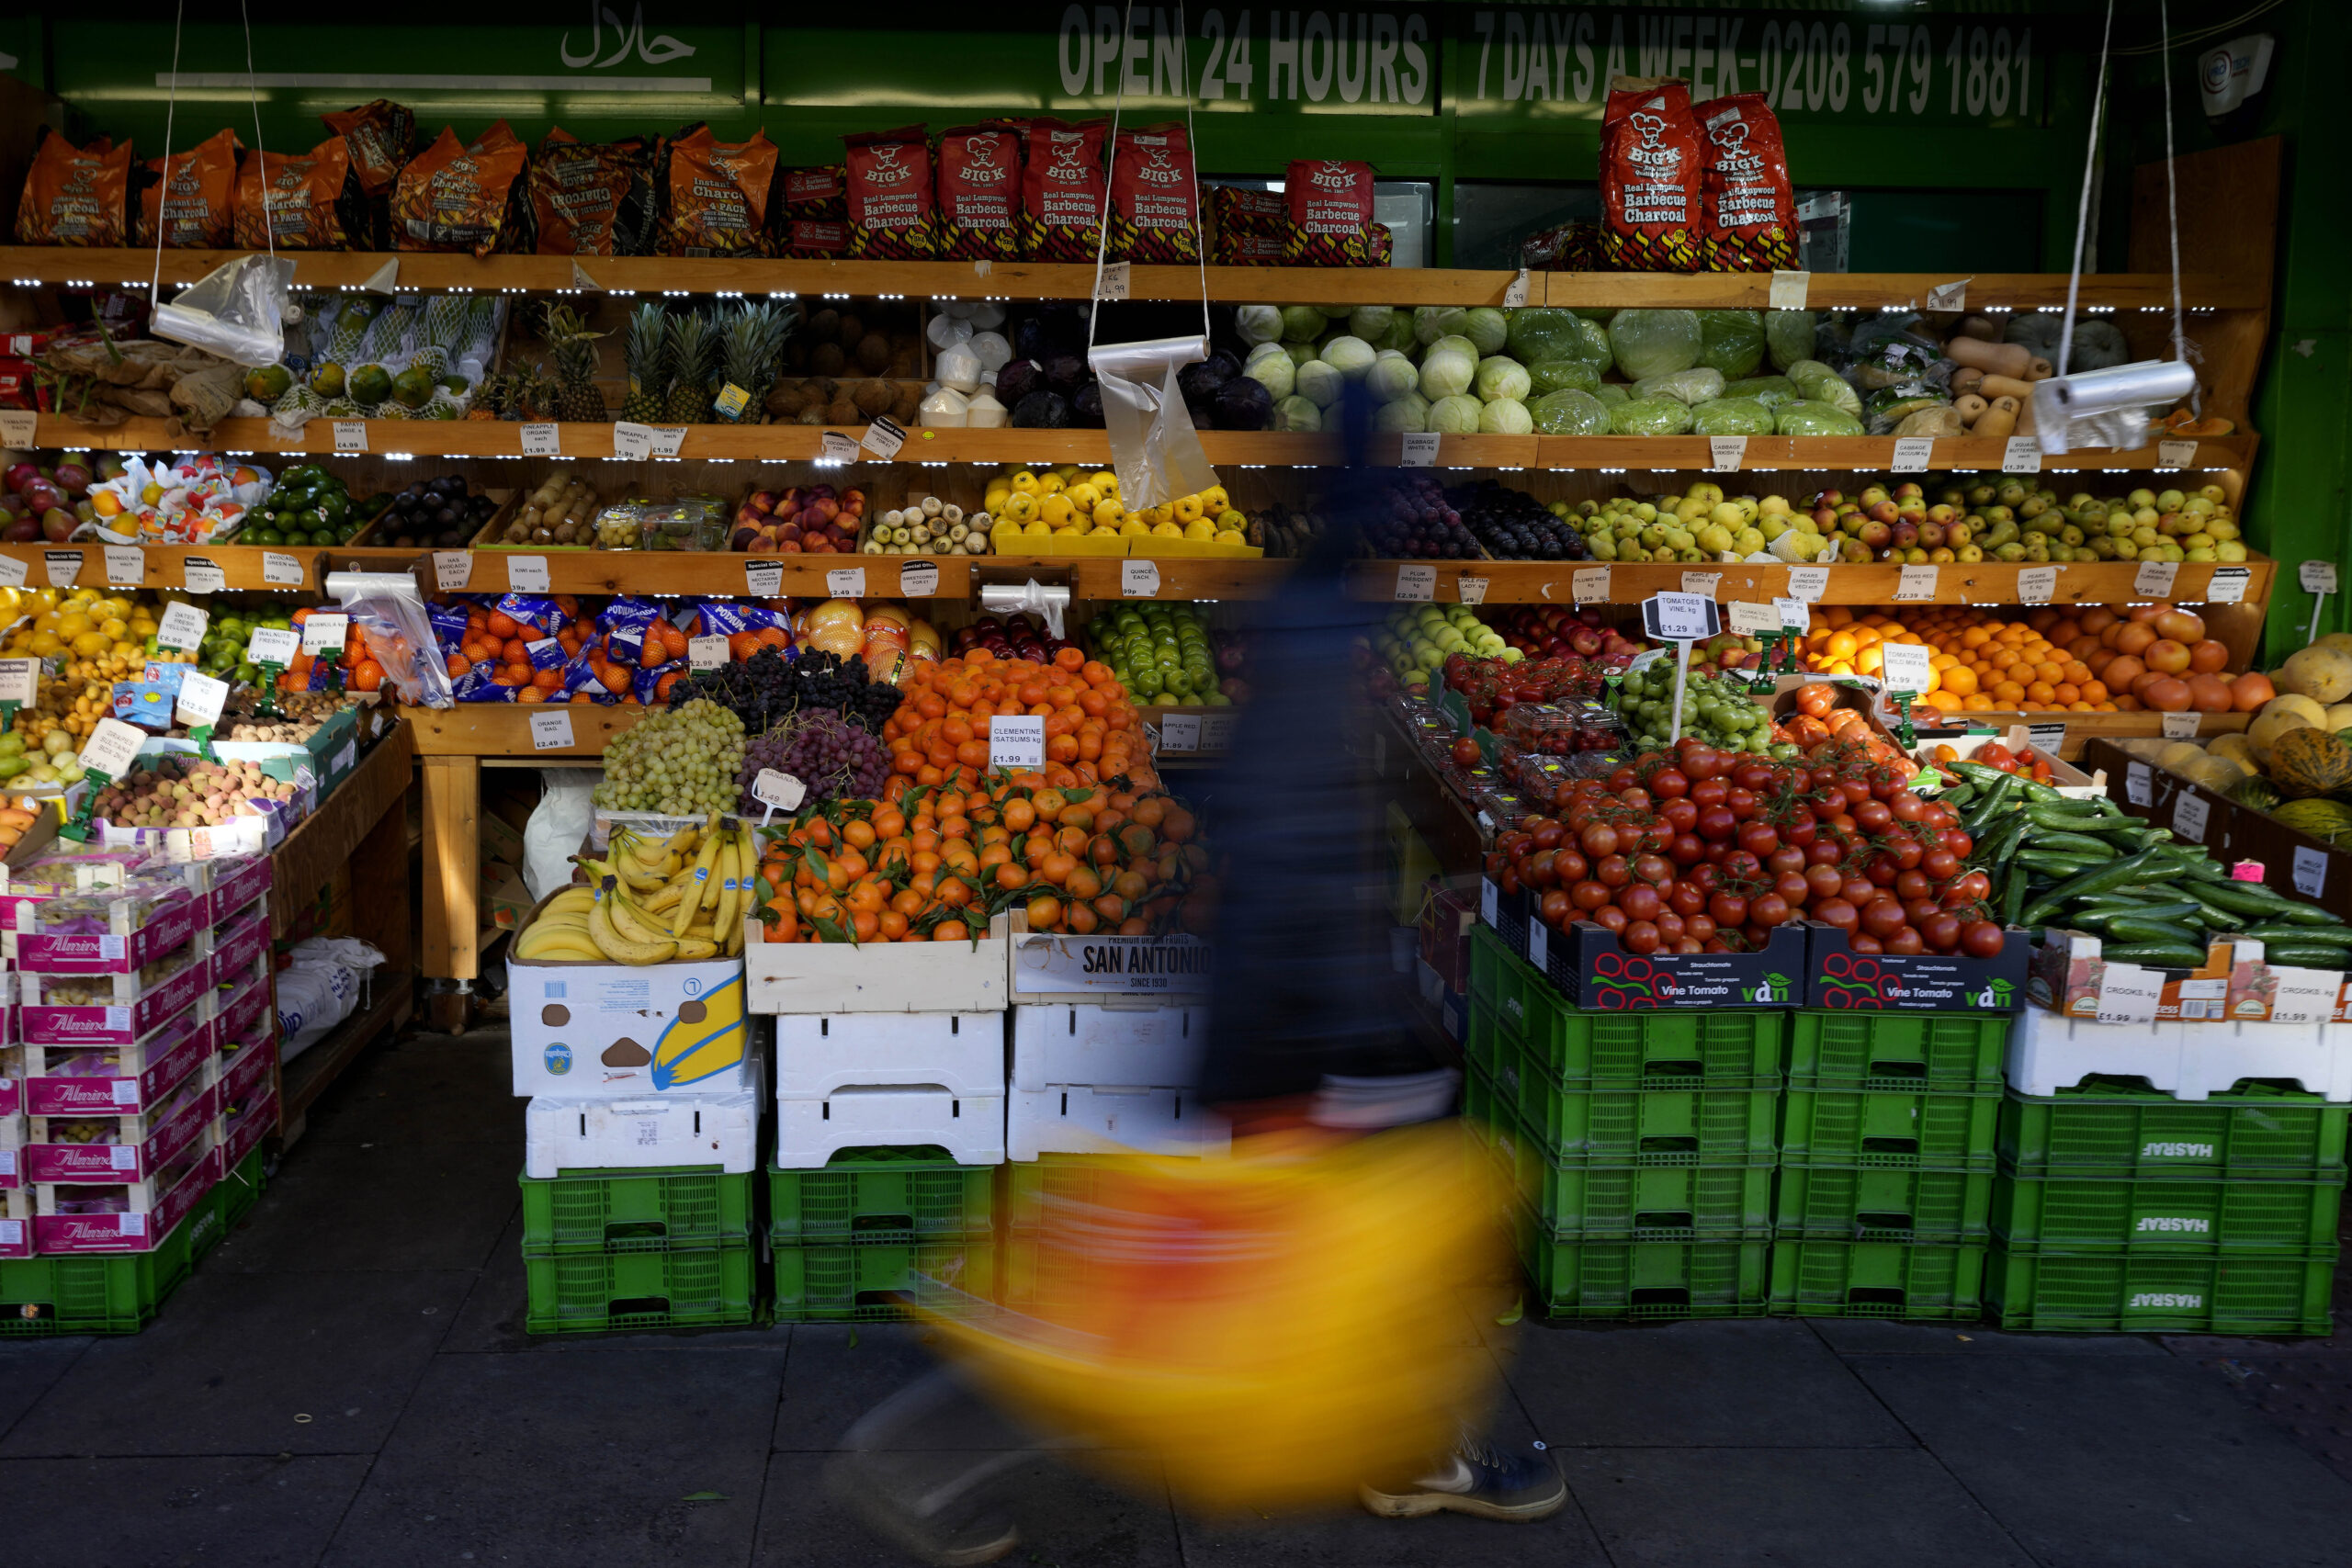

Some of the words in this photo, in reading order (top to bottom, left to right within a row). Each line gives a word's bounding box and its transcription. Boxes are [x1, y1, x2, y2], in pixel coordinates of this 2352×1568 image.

[560, 0, 696, 68] حلال
[1058, 3, 1183, 96] OPEN
[1198, 8, 1253, 100] 24
[1269, 9, 1429, 105] HOURS
[1474, 11, 1495, 101] 7
[1503, 11, 1595, 104] DAYS
[1603, 12, 1627, 101] A
[1863, 22, 1929, 114] 579
[1946, 25, 2032, 117] 1881
[1627, 147, 1663, 164] BIG
[1666, 147, 1682, 164] K
[1715, 159, 1749, 173] BIG
[1749, 154, 1766, 169] K
[865, 168, 896, 184] BIG
[896, 164, 912, 179] K
[958, 166, 992, 183] BIG
[990, 165, 1007, 179] K
[1046, 165, 1076, 180] BIG
[1076, 165, 1089, 179] K
[1137, 166, 1168, 183] BIG
[1169, 167, 1182, 181] K
[431, 175, 481, 194] Charcoal
[1310, 172, 1341, 187] BIG
[1343, 172, 1357, 186] K
[1624, 184, 1645, 193] Real
[552, 187, 612, 209] Charcoal
[863, 196, 878, 204] Real
[879, 193, 918, 201] Lumpwood
[973, 195, 1007, 203] Lumpwood
[1059, 192, 1095, 201] Lumpwood
[1152, 195, 1187, 204] Lumpwood
[1624, 194, 1687, 208] Barbecue
[51, 203, 99, 215] Charcoal
[262, 198, 312, 212] Charcoal
[709, 202, 717, 210] 4
[864, 202, 919, 217] Barbecue
[956, 203, 1009, 215] Barbecue
[1043, 200, 1096, 213] Barbecue
[1135, 203, 1187, 216] Barbecue
[1324, 200, 1360, 209] Lumpwood
[1718, 197, 1776, 213] Barbecue
[162, 206, 209, 220] Charcoal
[279, 212, 303, 221] PACK
[1044, 213, 1096, 226] Charcoal
[1306, 209, 1360, 220] Barbecue
[1624, 208, 1687, 223] Charcoal
[1718, 210, 1780, 229] Charcoal
[865, 214, 920, 230] Charcoal
[957, 217, 1010, 229] Charcoal
[1135, 216, 1188, 230] Charcoal
[1306, 221, 1360, 235] Charcoal
[876, 419, 895, 433] Special
[872, 429, 896, 446] COCONUTS
[876, 437, 887, 446] FOR
[1662, 597, 1700, 605] TOMATOES
[175, 610, 196, 620] DATES
[714, 604, 747, 631] PODIUM
[1738, 609, 1769, 617] TOMATO
[1661, 625, 1688, 633] £1.29
[250, 653, 275, 661] £4.99
[1887, 651, 1924, 660] TOMATOES
[1917, 660, 1927, 669] kg
[1885, 675, 1910, 684] £4.99
[180, 699, 209, 714] £12.99
[993, 728, 1041, 736] CLEMENTINE
[993, 735, 1031, 743] /SATSUMS
[1033, 736, 1041, 745] kg
[993, 755, 1021, 764] £1.99
[763, 770, 794, 784] BANANA
[760, 793, 780, 802] 1.49
[2182, 800, 2200, 813] MELON
[1165, 935, 1189, 944] FRUITS
[1082, 945, 1123, 974] SAN
[1127, 946, 1213, 975] ANTONIO
[1130, 978, 1150, 987] SINCE
[1151, 978, 1168, 987] 1930
[1661, 986, 1686, 996] Vine
[1688, 986, 1729, 996] Tomato
[1887, 987, 1911, 998] Vine
[1913, 987, 1953, 998] Tomato
[2146, 990, 2158, 998] kg
[2325, 989, 2335, 998] kg
[2098, 1012, 2131, 1021] £1.99
[2274, 1012, 2307, 1021] £1.99
[2142, 1142, 2213, 1157] HASRAF
[2136, 1217, 2210, 1233] HASRAF
[2129, 1293, 2202, 1308] HASRAF
